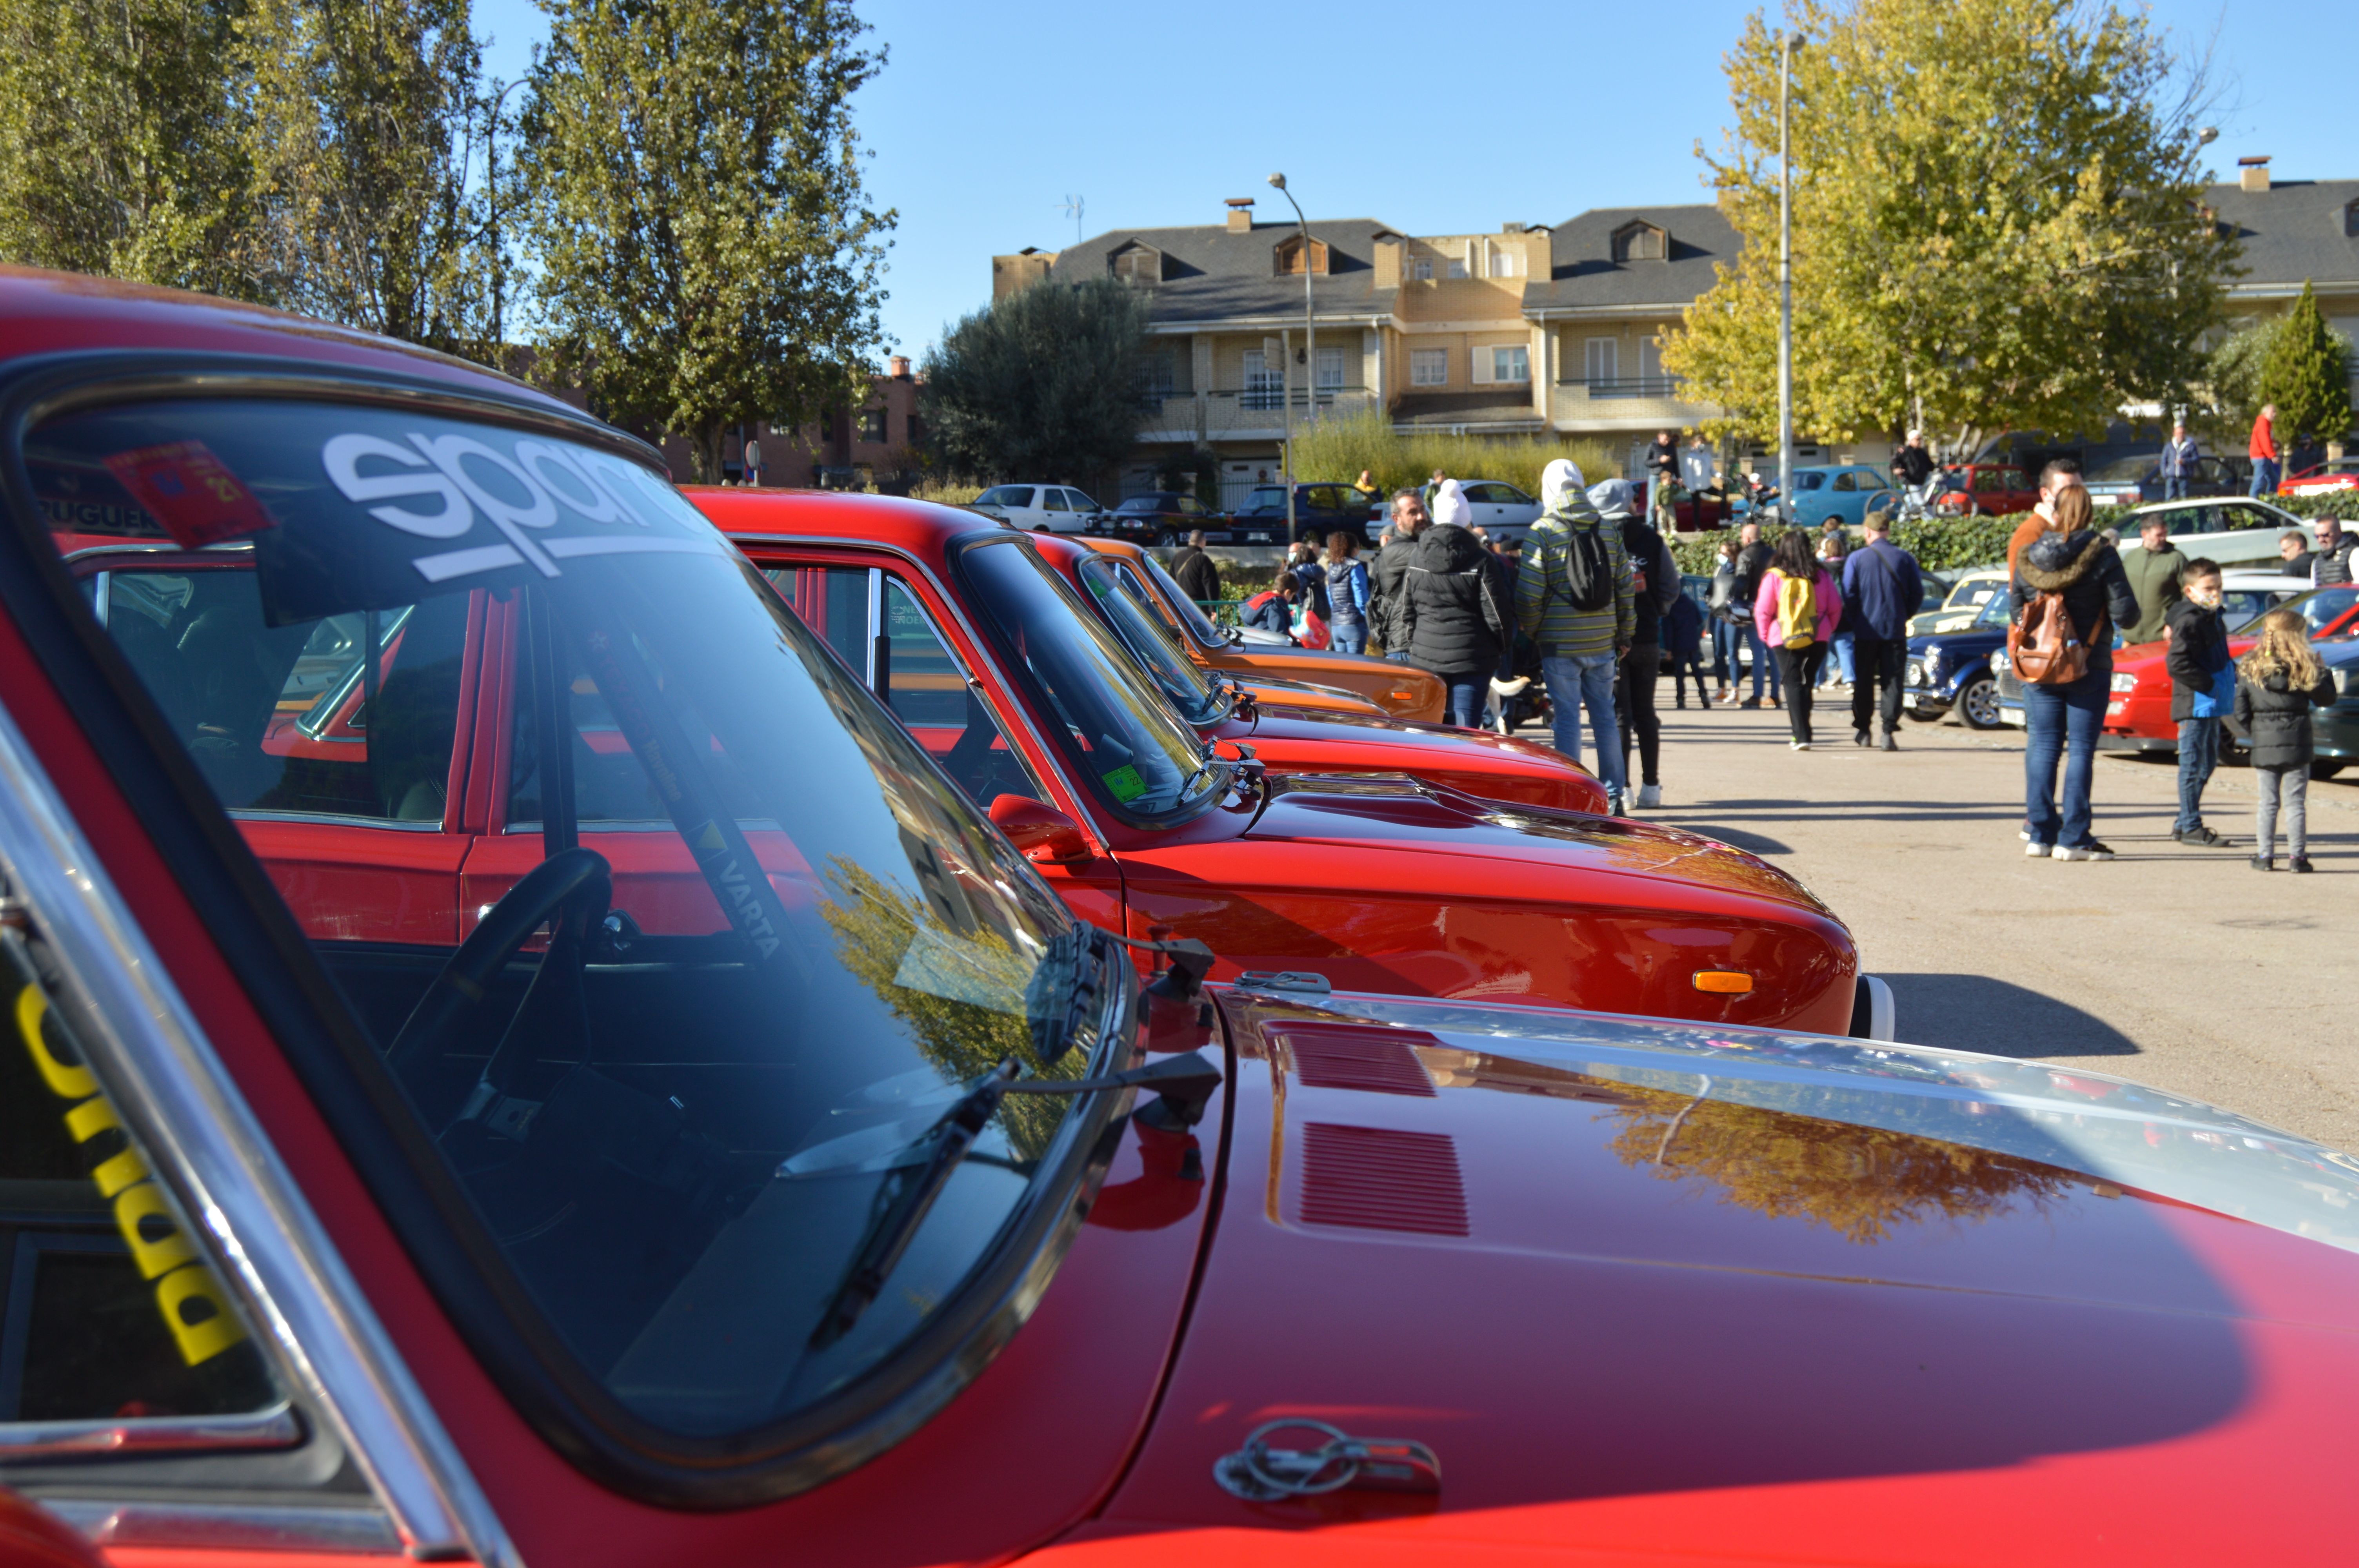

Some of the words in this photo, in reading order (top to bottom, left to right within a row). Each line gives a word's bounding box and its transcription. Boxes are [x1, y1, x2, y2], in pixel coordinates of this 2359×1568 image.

[642, 740, 683, 802] Havoline
[1130, 777, 1141, 786] 22
[719, 859, 780, 960] VARTA
